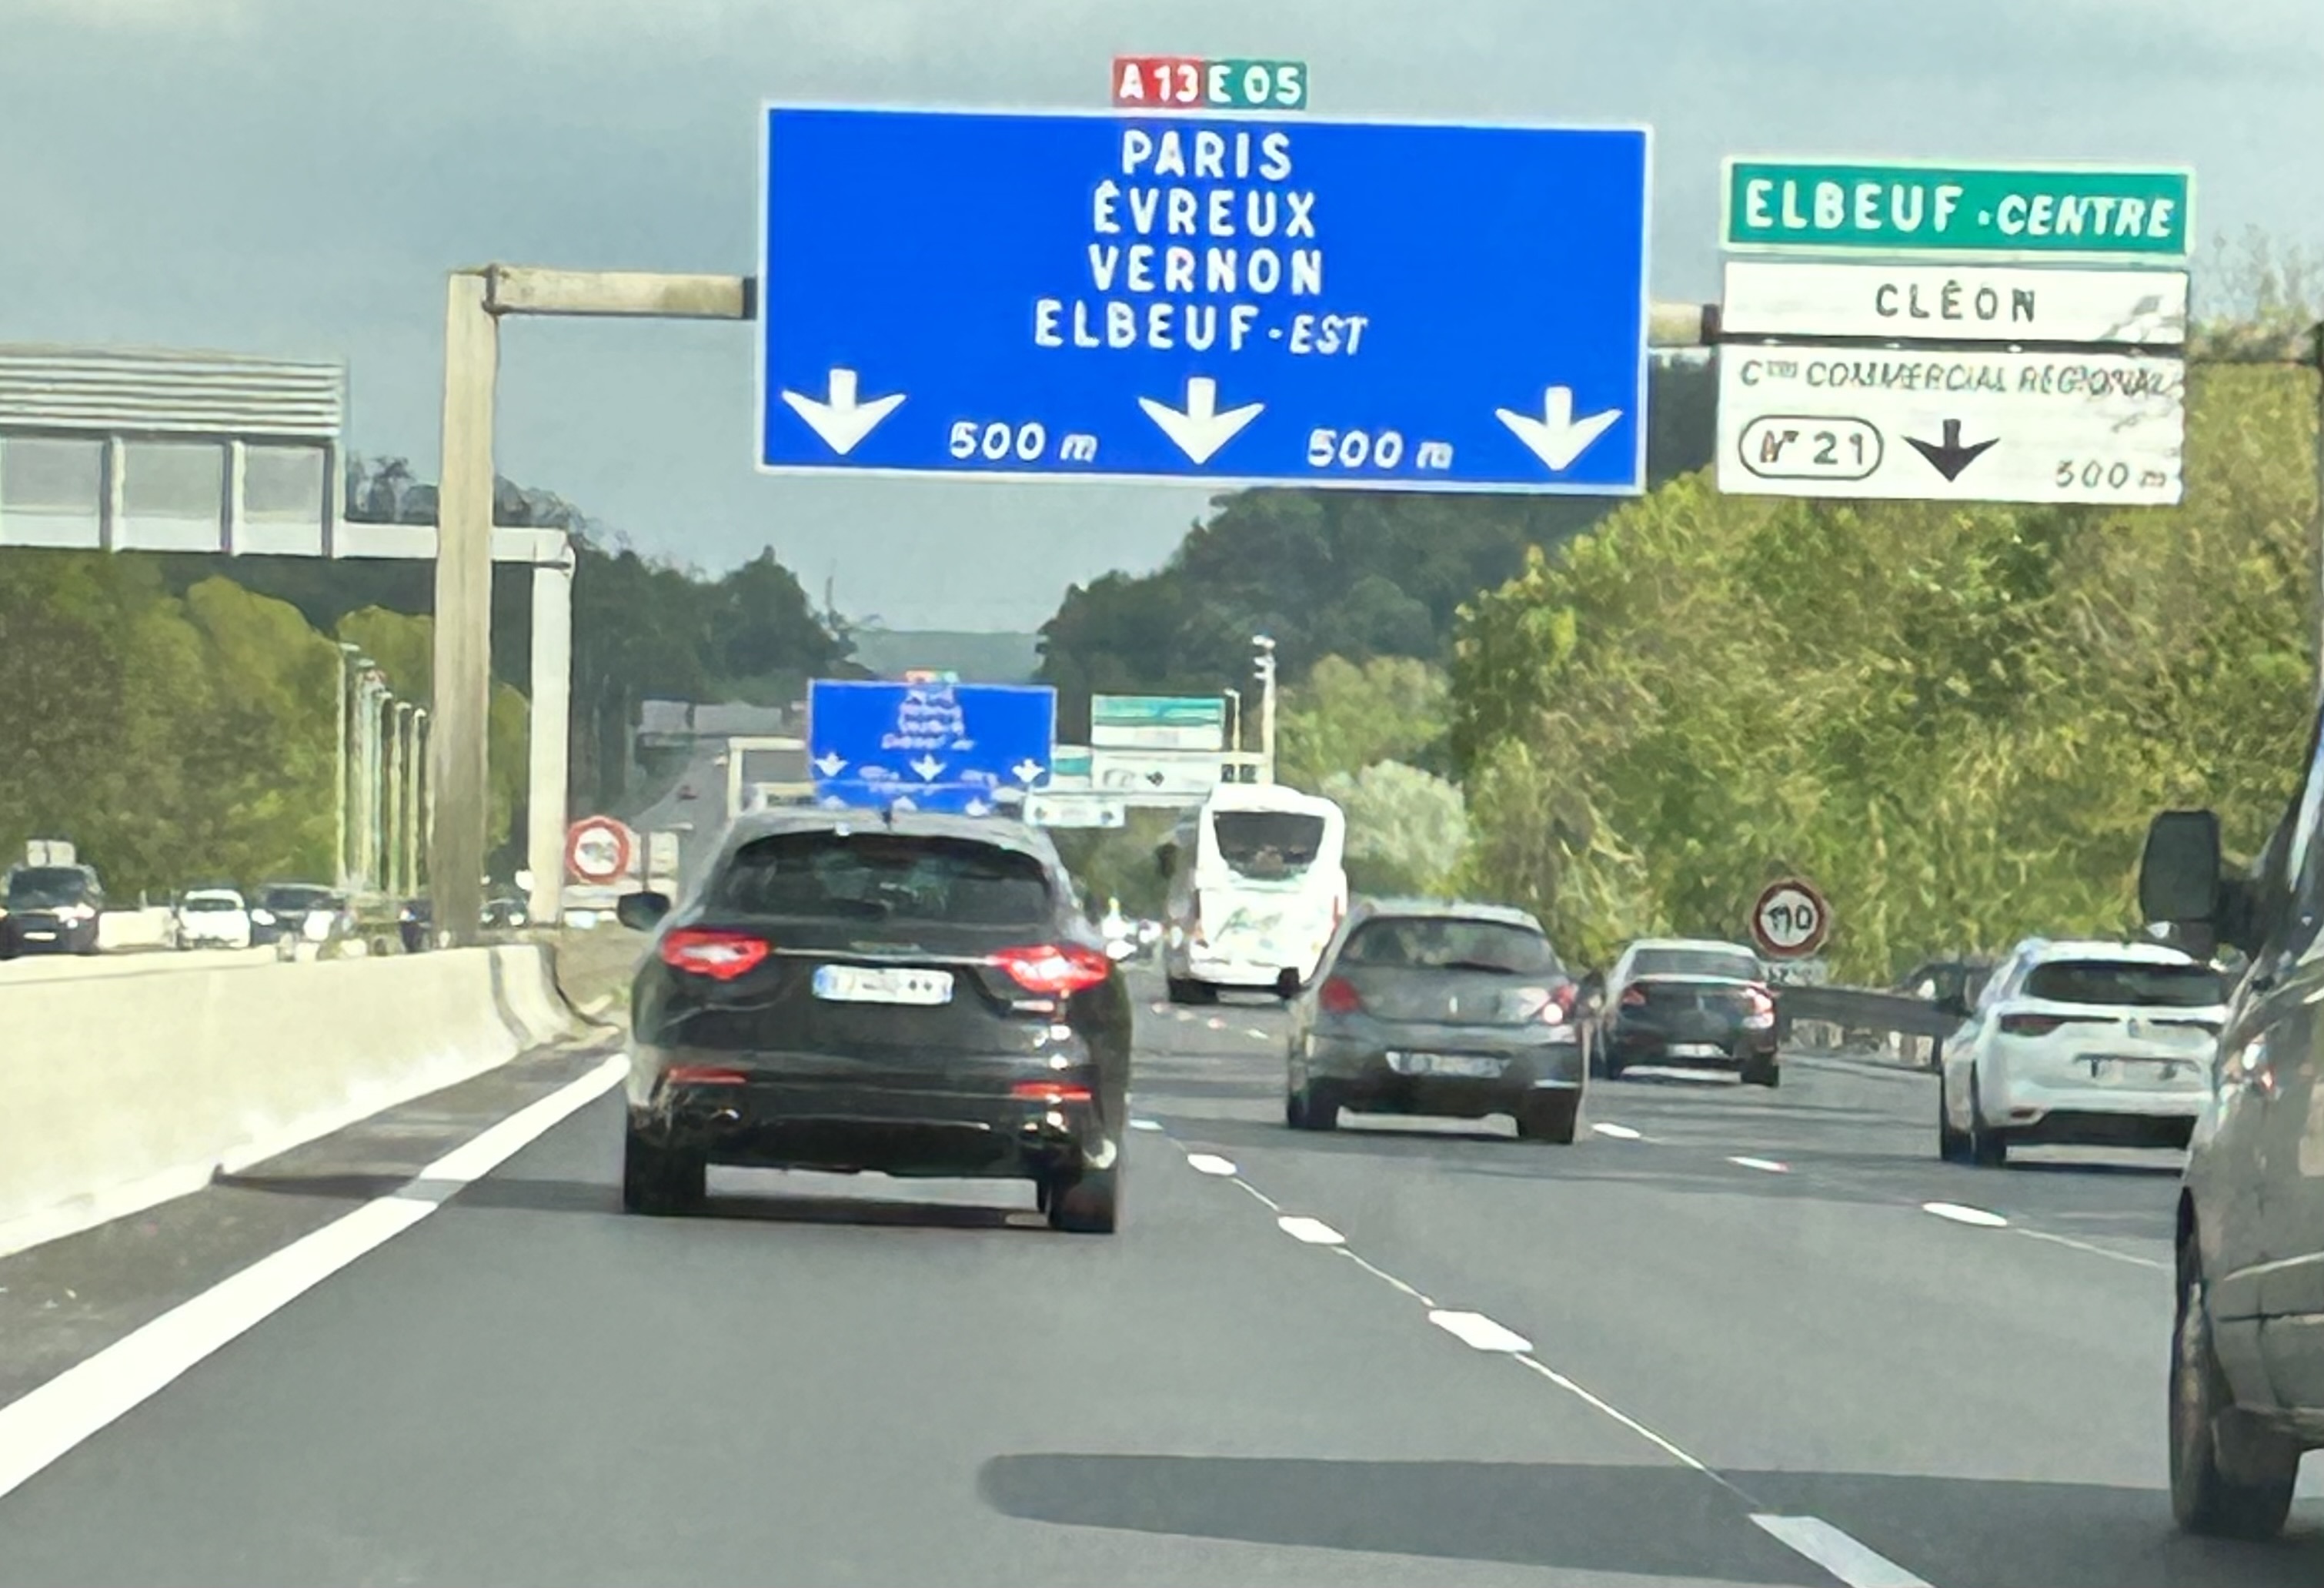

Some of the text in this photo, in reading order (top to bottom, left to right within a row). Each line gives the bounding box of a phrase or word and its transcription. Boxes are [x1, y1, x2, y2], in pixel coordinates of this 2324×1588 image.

[1122, 129, 1292, 181] PARIS
[1087, 243, 1322, 296] VERNON
[950, 421, 1098, 462] 500 m
[1307, 428, 1403, 469] 500
[1813, 430, 1863, 466] 21
